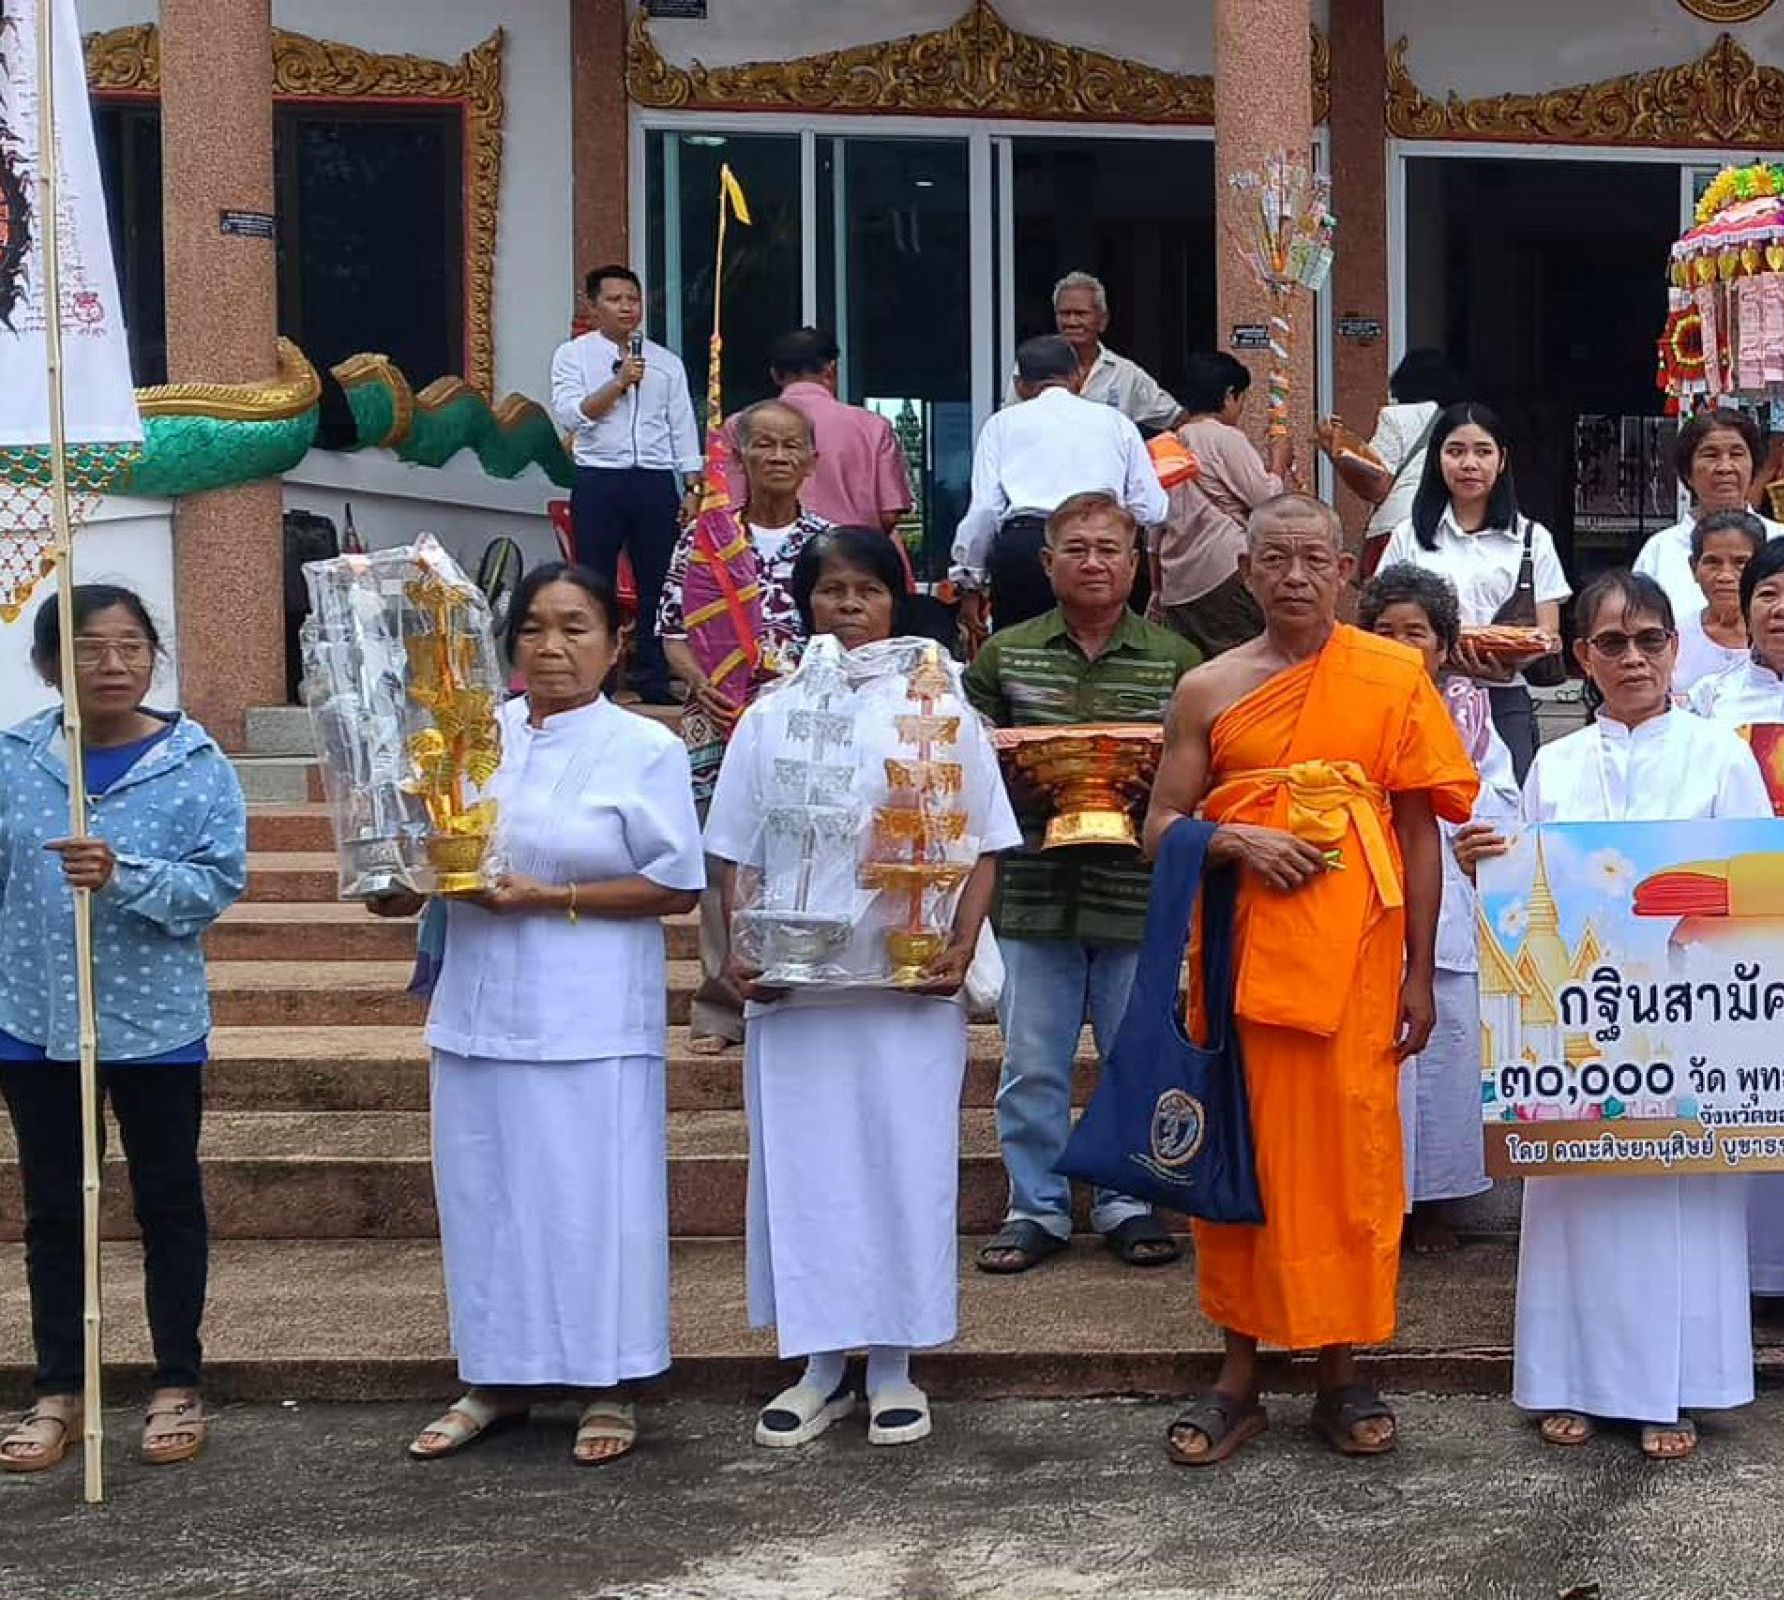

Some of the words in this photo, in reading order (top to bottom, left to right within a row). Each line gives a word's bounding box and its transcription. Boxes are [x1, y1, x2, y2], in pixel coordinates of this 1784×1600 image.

[1500, 1062, 1675, 1105] ๓๐,๐๐๐
[1688, 1055, 1726, 1093] วัด
[1506, 1135, 1546, 1162] โดย
[1554, 1130, 1715, 1166] คณะศิษยานุศิษย์
